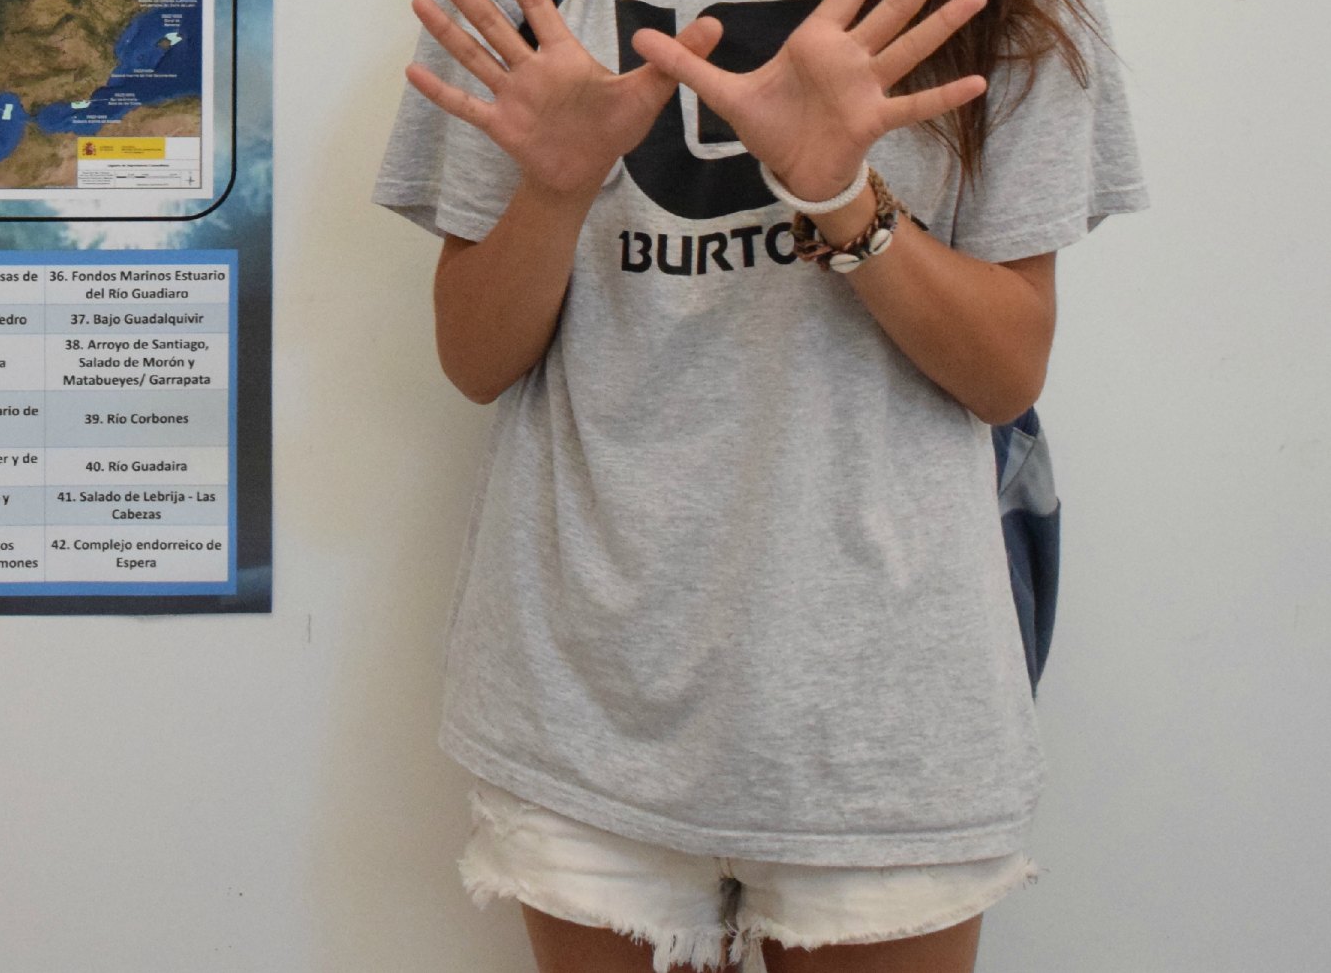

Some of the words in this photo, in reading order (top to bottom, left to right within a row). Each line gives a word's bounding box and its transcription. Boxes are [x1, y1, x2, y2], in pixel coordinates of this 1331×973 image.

[618, 222, 797, 276] BURTO
[71, 314, 89, 325] 37.
[94, 314, 121, 327] Bajo
[124, 313, 204, 326] Guadalquivir
